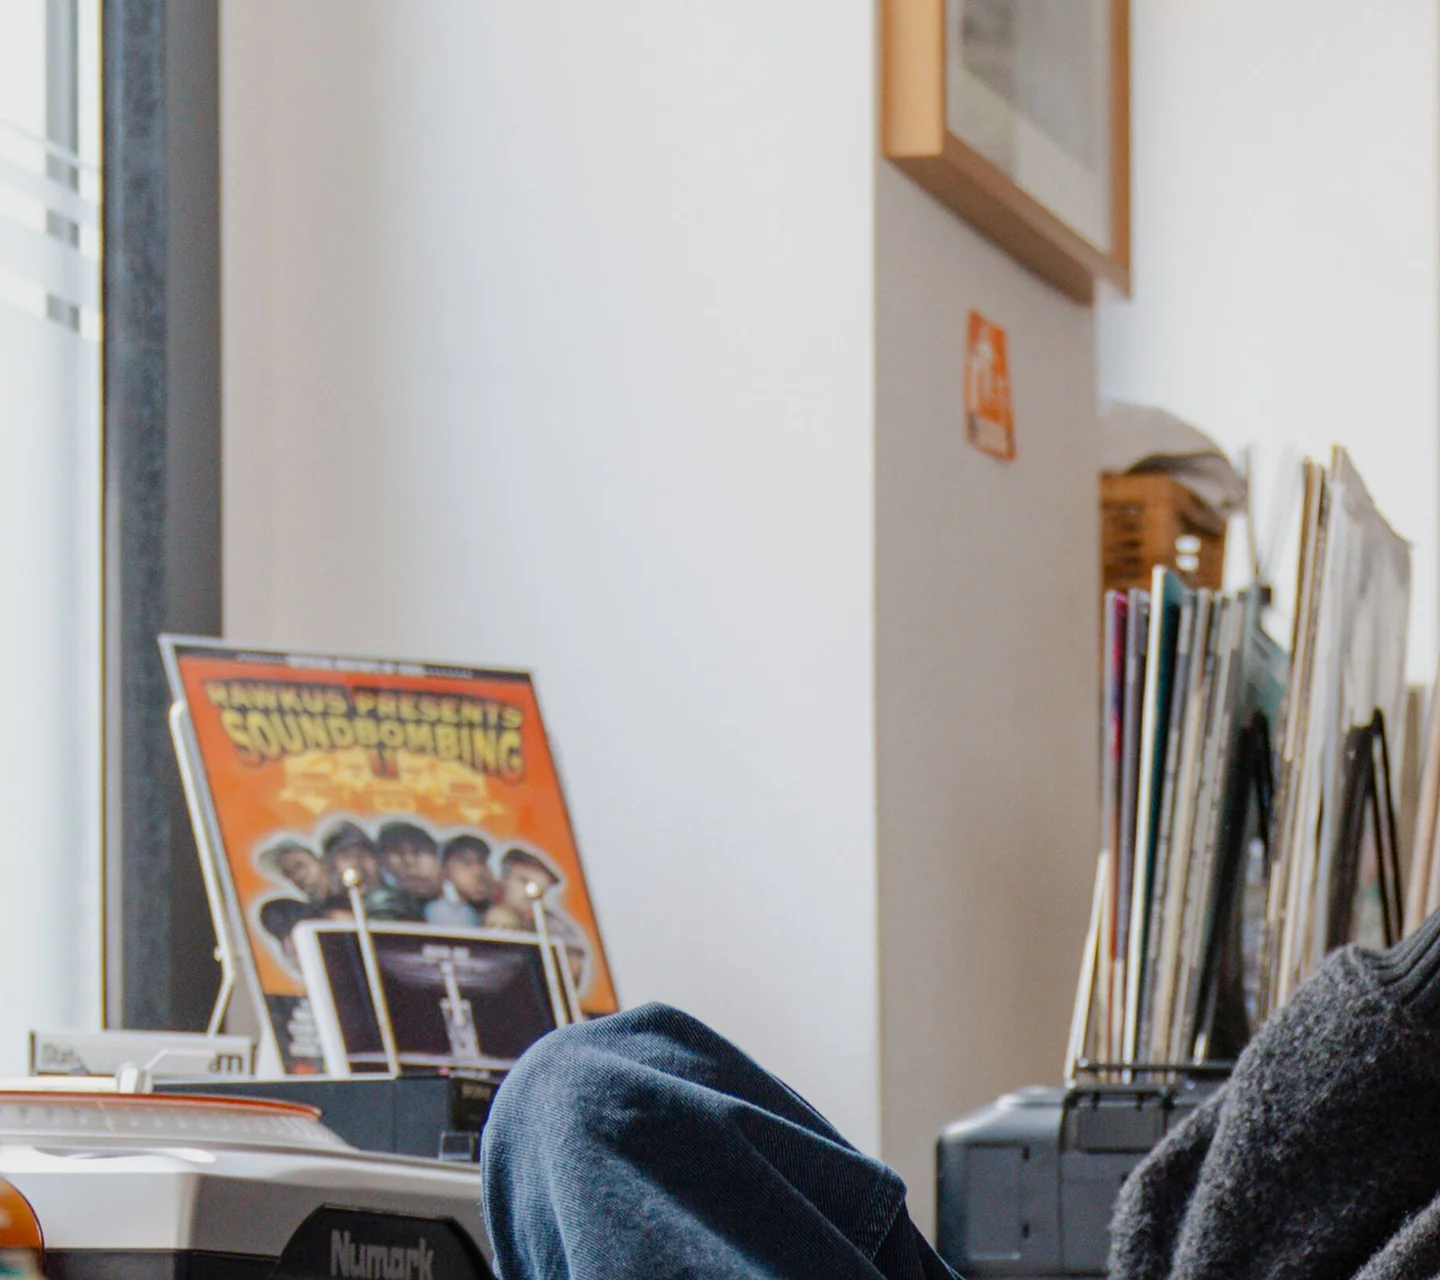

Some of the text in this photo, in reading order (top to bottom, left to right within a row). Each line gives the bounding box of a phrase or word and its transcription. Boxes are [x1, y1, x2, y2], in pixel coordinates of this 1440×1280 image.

[204, 678, 522, 729] RAWKUS PRESENTS
[220, 706, 523, 780] SOUNDBOMBING
